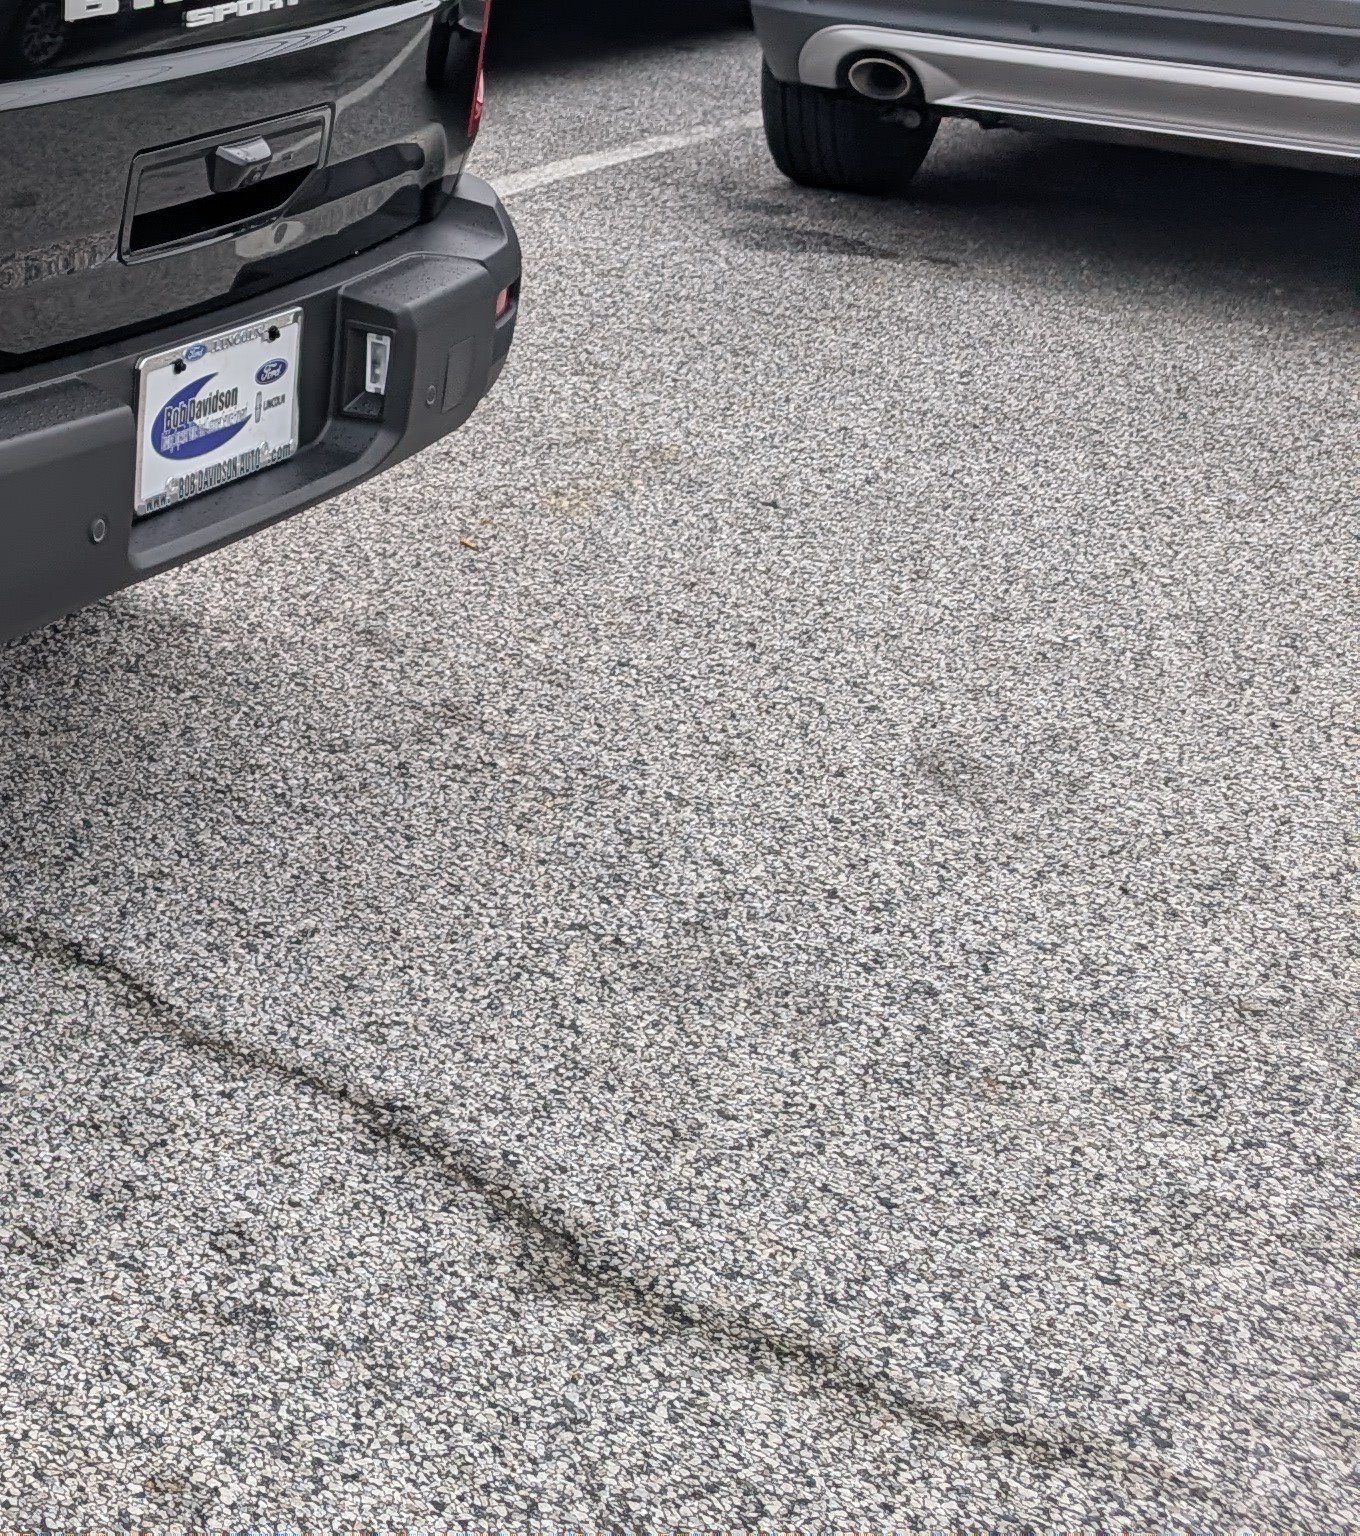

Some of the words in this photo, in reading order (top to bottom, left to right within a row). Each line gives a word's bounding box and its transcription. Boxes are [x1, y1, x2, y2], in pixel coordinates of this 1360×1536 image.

[165, 402, 188, 432] Bob
[188, 387, 238, 423] Davidson
[179, 473, 196, 498] BOB
[197, 456, 238, 492] DAVIDSON
[239, 447, 260, 475] AUTO
